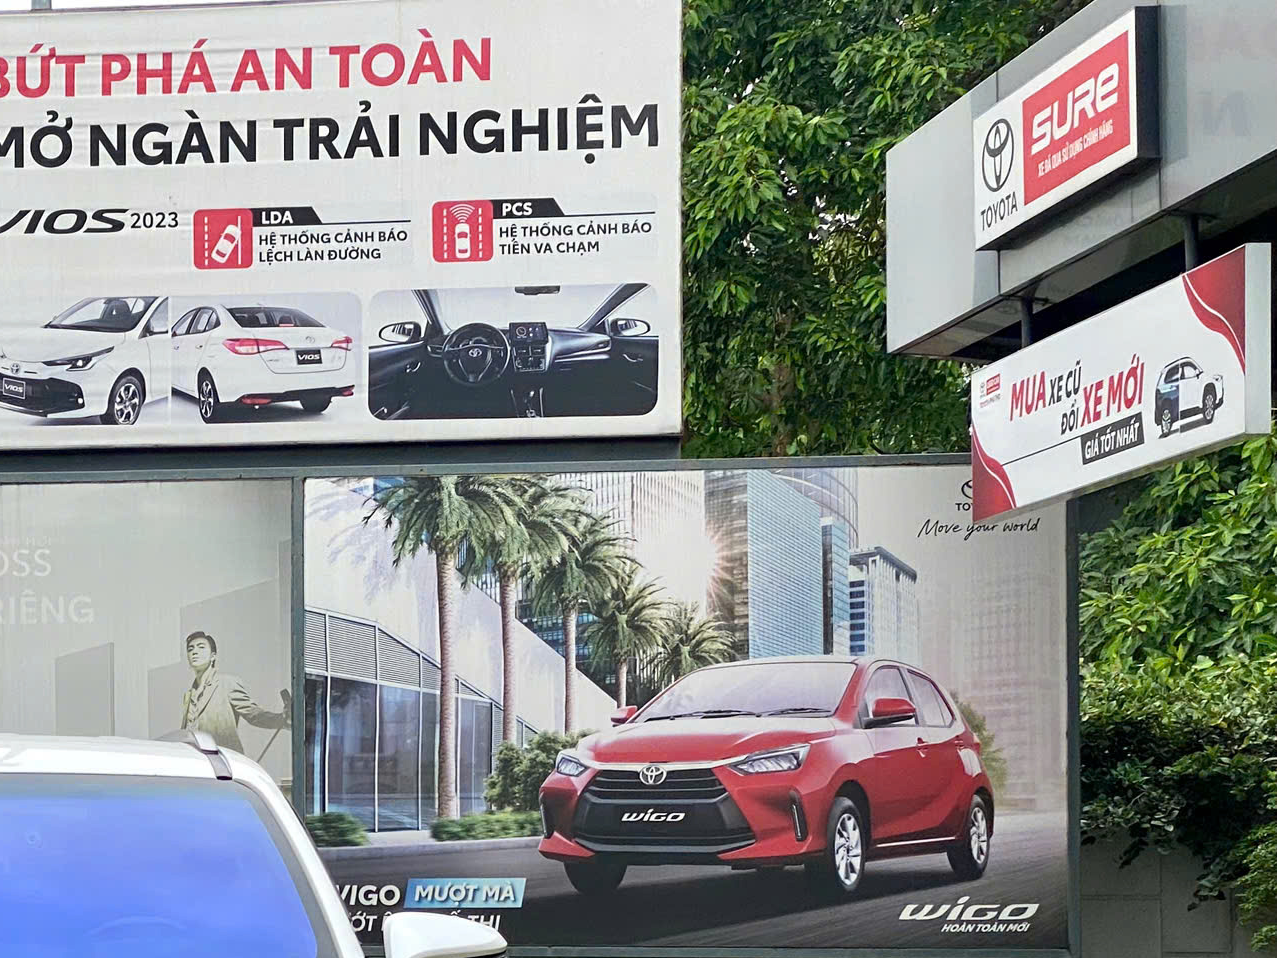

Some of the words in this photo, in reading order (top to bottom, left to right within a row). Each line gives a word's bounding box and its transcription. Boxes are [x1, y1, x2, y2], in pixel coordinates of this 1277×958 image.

[101, 38, 217, 96] PHÁ
[230, 47, 312, 92] AN
[329, 28, 491, 88] TOÀN
[89, 110, 256, 167] NGÀN
[273, 100, 399, 161] TRẢI
[419, 93, 658, 164] NGHIỆM
[261, 211, 293, 224] LDA
[502, 202, 532, 216] PCS
[980, 191, 1018, 231] TOYOTA
[130, 212, 179, 229] 2023
[499, 223, 517, 240] HỆ
[521, 222, 573, 237] THỐNG
[577, 219, 617, 235] CẢNH
[622, 219, 652, 234] BÁO
[259, 231, 276, 247] HỆ
[280, 229, 331, 245] THỐNG
[334, 229, 374, 243] CẢNH
[379, 228, 408, 242] BÁO
[259, 249, 293, 265] LỆCH
[297, 248, 323, 262] LÀN
[328, 245, 381, 260] ĐƯỜNG
[534, 243, 553, 254] VA
[556, 241, 599, 256] CHẠM
[4, 384, 23, 393] VIOS
[1010, 371, 1046, 422] MUA
[1048, 375, 1063, 406] XE
[1065, 360, 1081, 398] CŨ
[1061, 399, 1079, 435] ĐỔI
[1080, 380, 1104, 427] XE
[1106, 353, 1145, 417] MỚI
[1085, 433, 1100, 459] GIÁ
[1100, 427, 1116, 453] TỐT
[1117, 418, 1140, 447] NHẤT
[917, 519, 962, 538] Move
[963, 523, 999, 541] your
[1003, 518, 1041, 532] world
[414, 881, 478, 906] MƯỢT
[482, 881, 515, 902] MÀ
[941, 922, 975, 933] HOÀN
[975, 921, 1007, 933] TOÀN
[1007, 921, 1031, 932] MỚI
